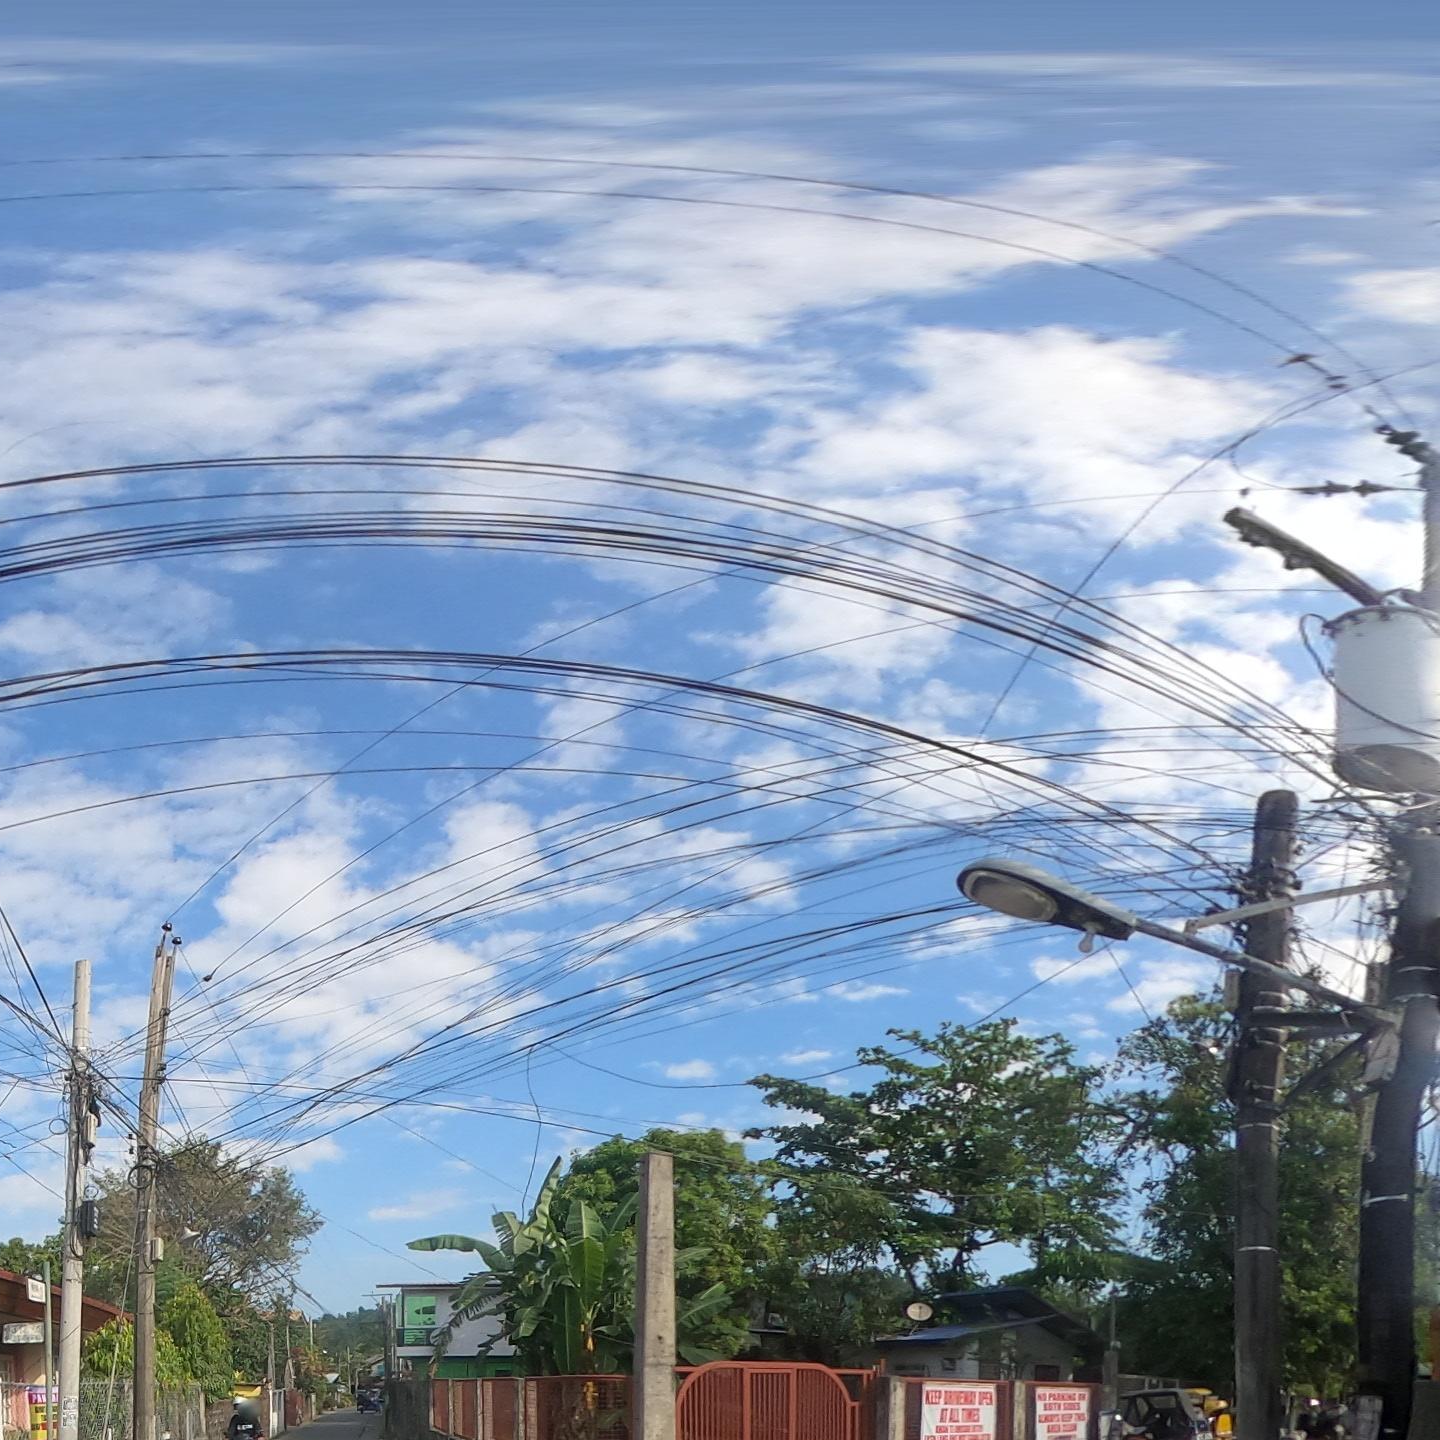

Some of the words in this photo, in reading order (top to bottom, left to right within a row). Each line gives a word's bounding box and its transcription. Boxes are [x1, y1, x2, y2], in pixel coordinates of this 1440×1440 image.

[925, 1390, 941, 1404] KEEP
[1049, 1393, 1076, 1401] PARKING
[949, 1408, 960, 1423] ALL
